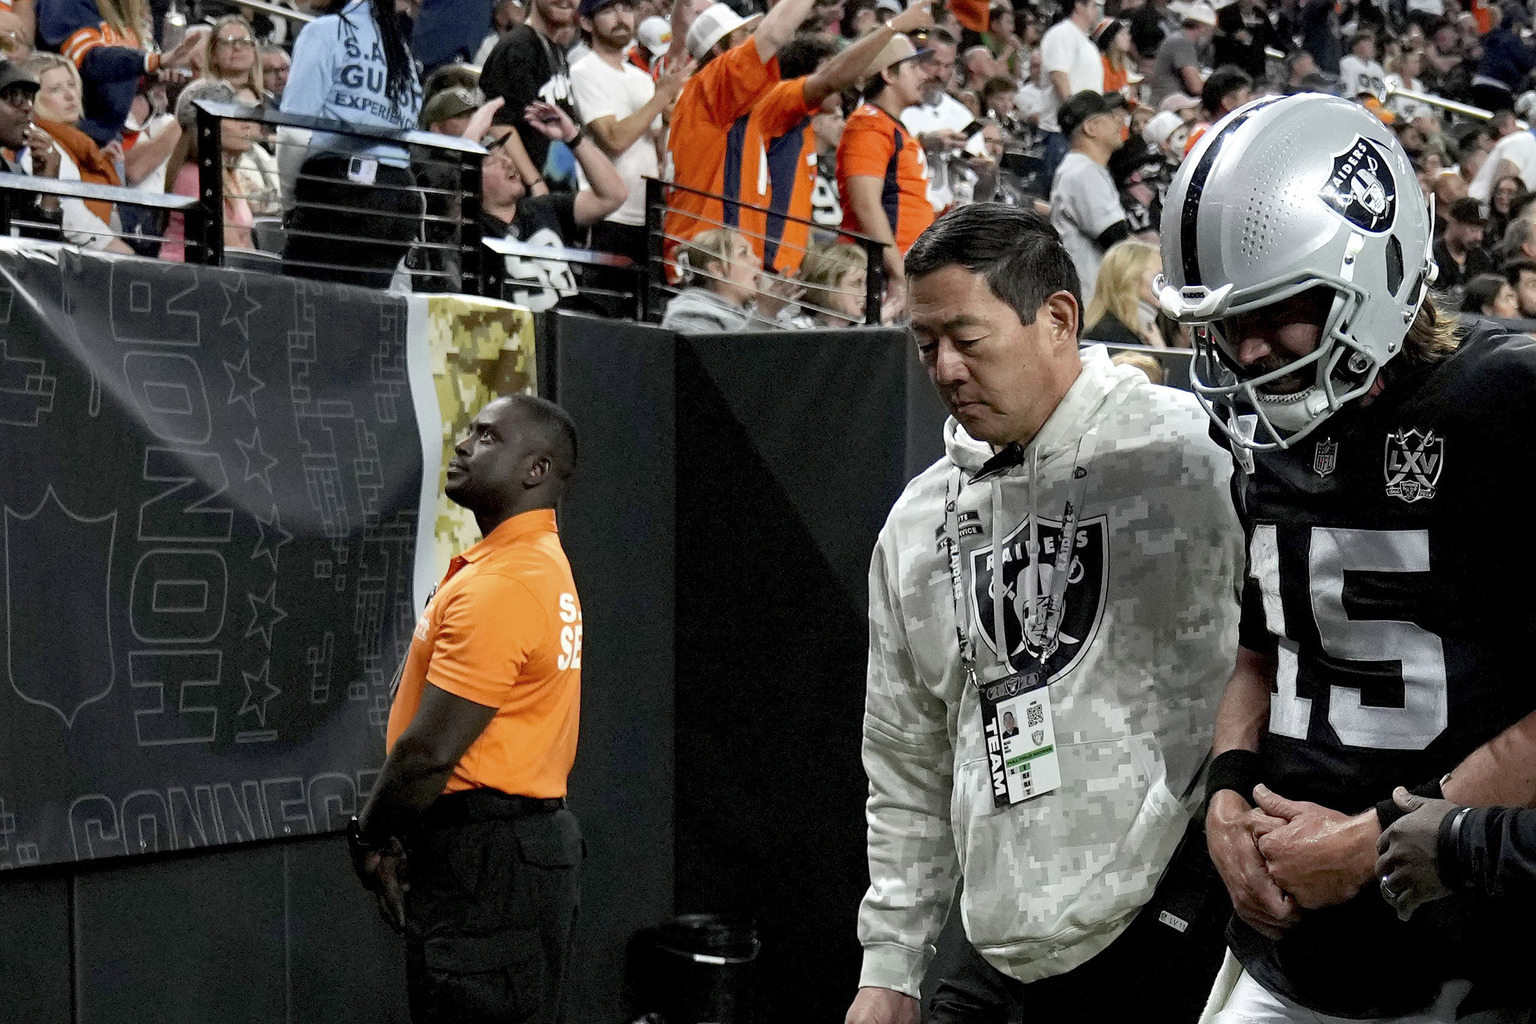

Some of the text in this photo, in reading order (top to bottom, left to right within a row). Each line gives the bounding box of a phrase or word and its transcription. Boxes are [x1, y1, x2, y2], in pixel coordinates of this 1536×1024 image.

[1322, 142, 1368, 197] AIDERS
[1388, 450, 1439, 475] LXV
[110, 263, 234, 746] HONOR
[1249, 523, 1449, 750] 15
[985, 716, 1007, 797] TEAM
